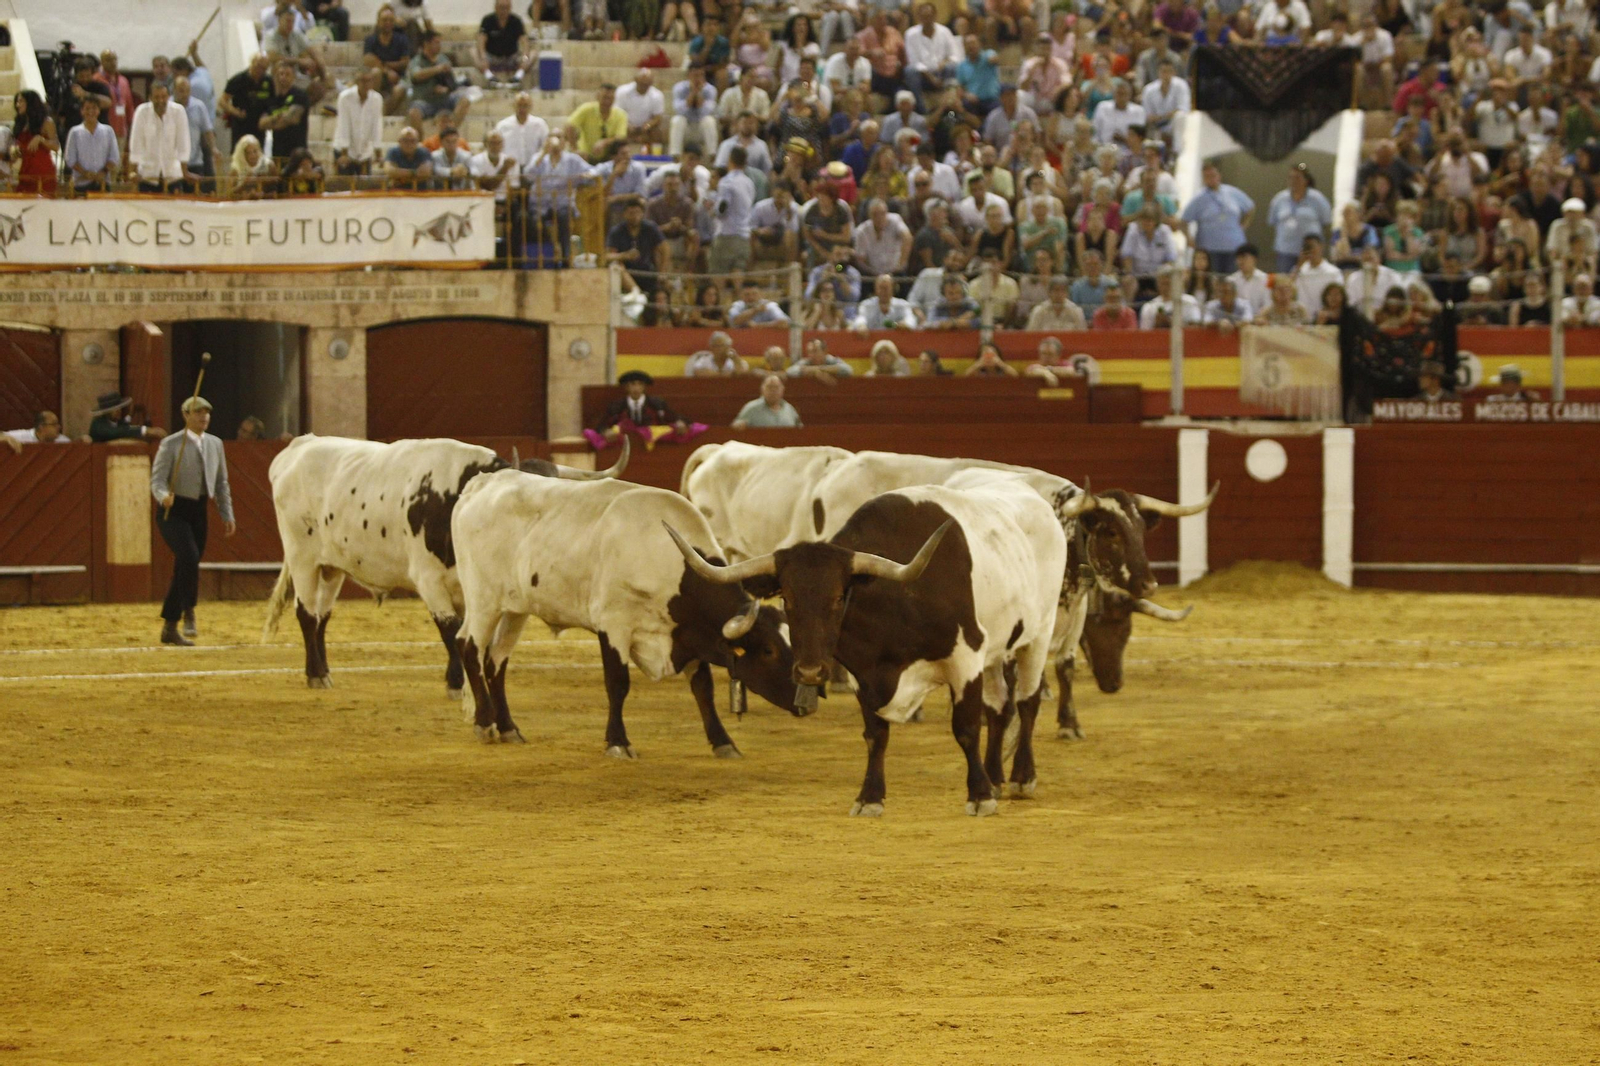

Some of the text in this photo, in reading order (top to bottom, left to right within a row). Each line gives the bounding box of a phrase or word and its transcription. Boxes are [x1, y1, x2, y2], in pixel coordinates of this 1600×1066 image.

[49, 217, 395, 247] LANCES DE FUTURO
[59, 291, 92, 302] PLAZA
[1373, 401, 1462, 420] MAYORALES
[1475, 401, 1528, 421] MOZOS
[1531, 401, 1549, 421] DE
